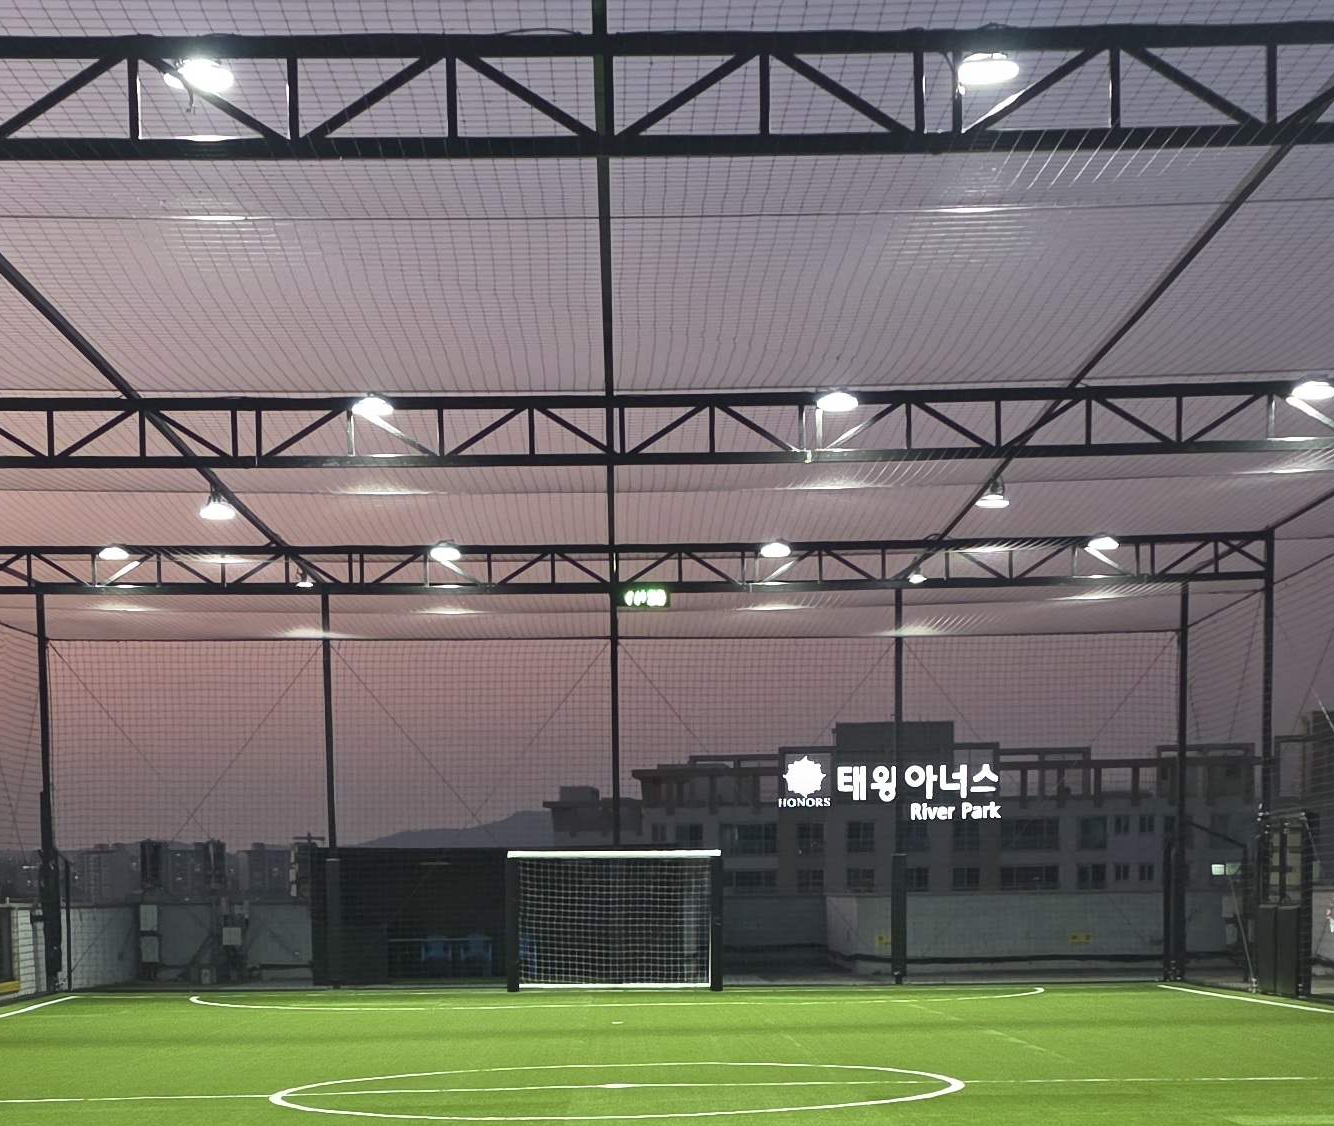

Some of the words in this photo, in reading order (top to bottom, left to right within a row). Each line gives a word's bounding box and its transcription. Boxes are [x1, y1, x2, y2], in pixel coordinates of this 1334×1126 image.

[777, 797, 831, 808] HONORS
[910, 802, 956, 821] River
[961, 801, 1002, 820] Park
